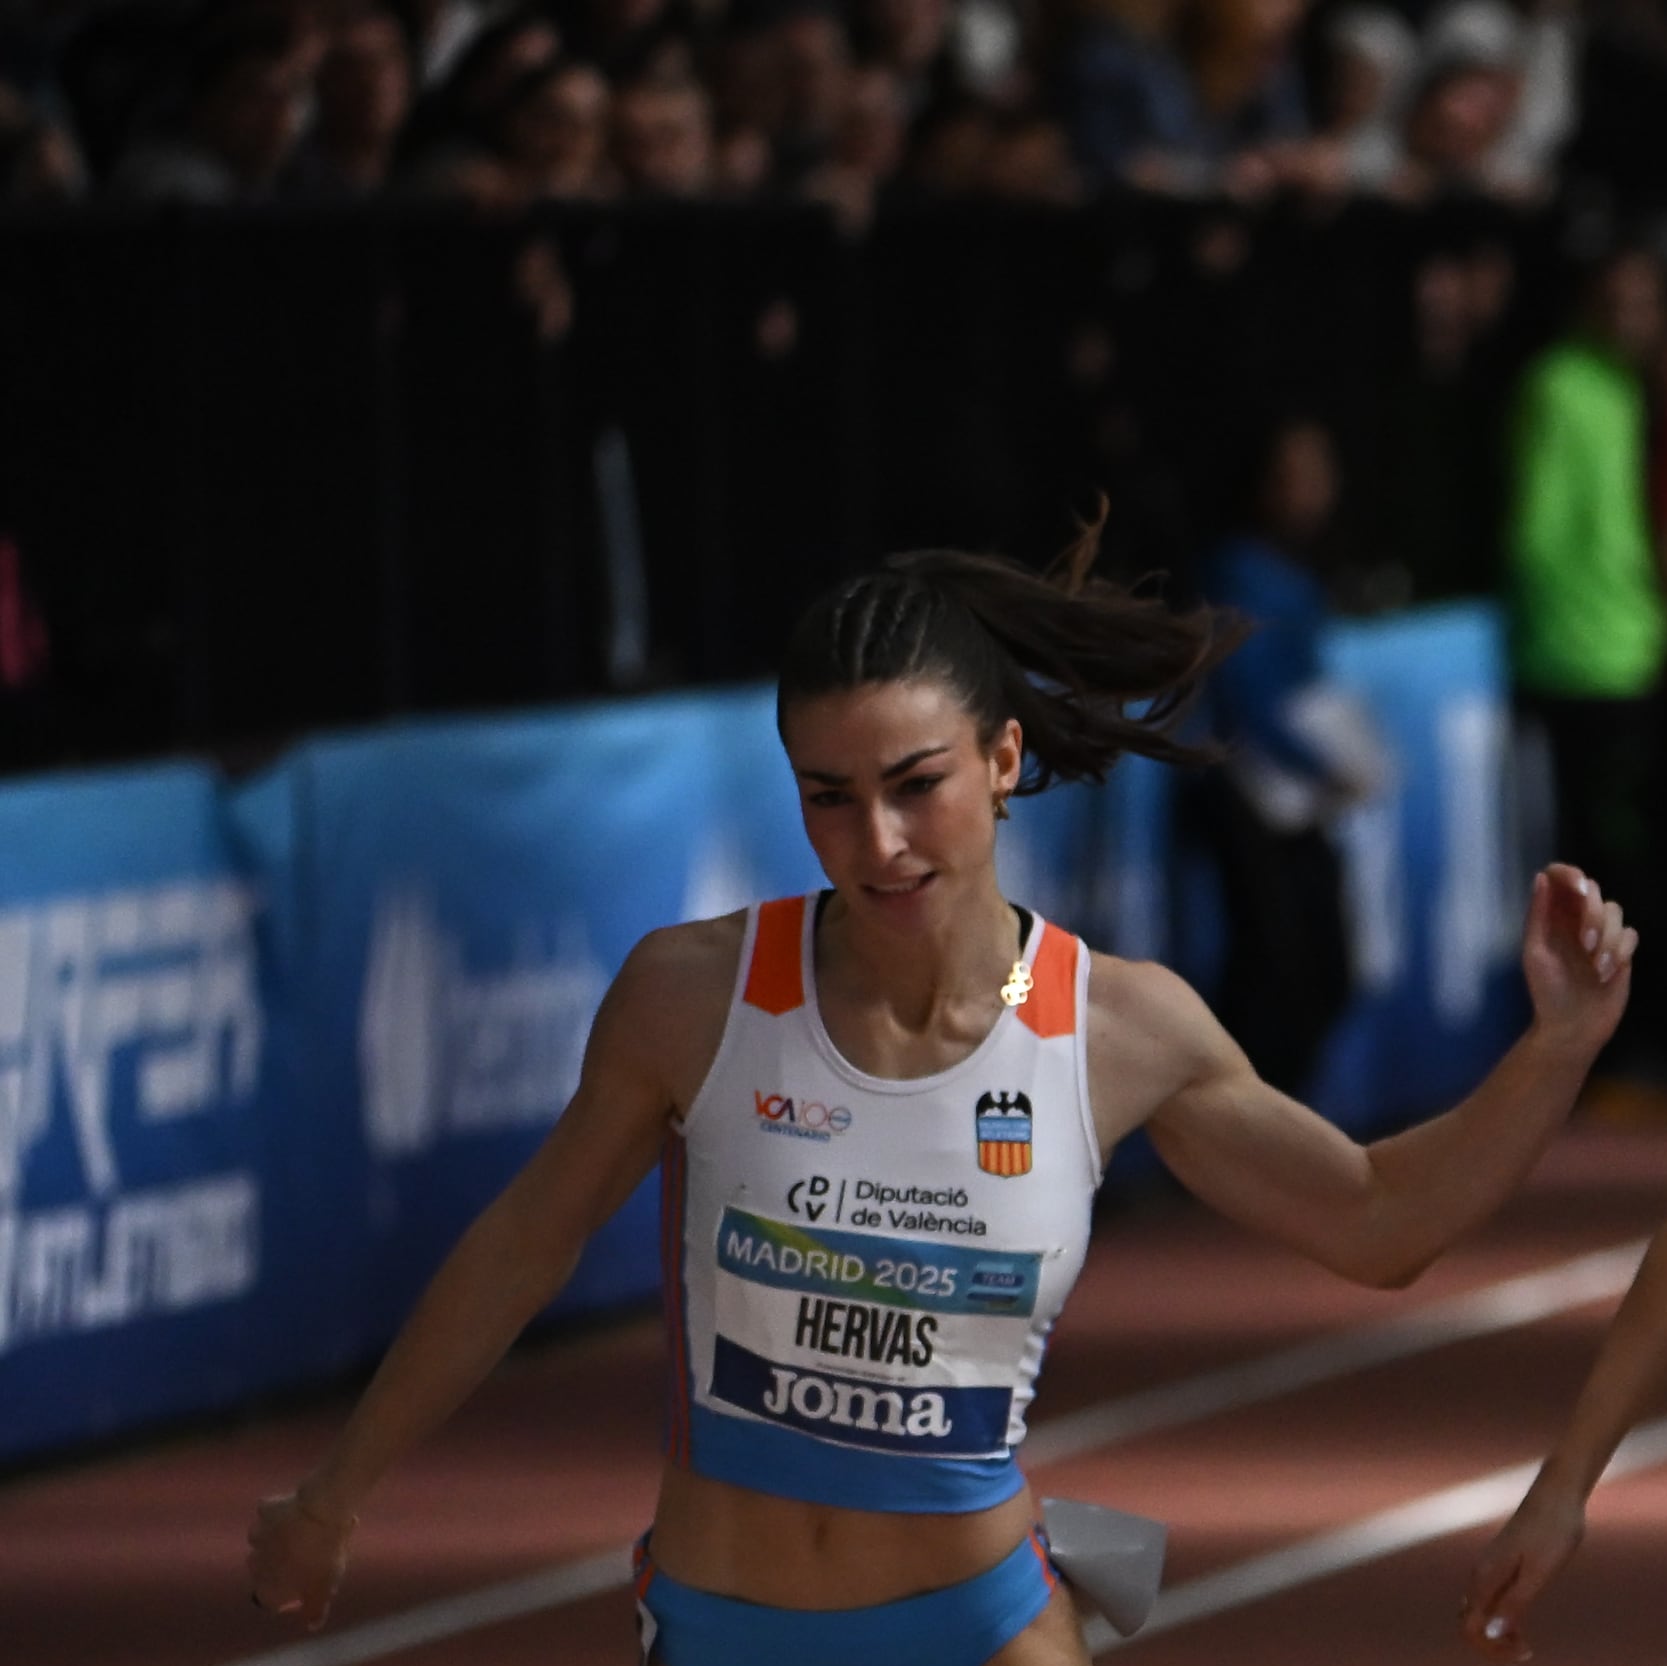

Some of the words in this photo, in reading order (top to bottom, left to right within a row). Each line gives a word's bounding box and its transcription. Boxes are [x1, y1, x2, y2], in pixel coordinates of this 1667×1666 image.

[851, 1207, 882, 1227] de
[887, 1209, 987, 1237] València
[855, 1180, 969, 1208] Diputació
[727, 1231, 867, 1283] MADRID
[872, 1259, 959, 1298] 2025
[795, 1296, 939, 1368] HERVAS
[763, 1367, 953, 1438] Joma
